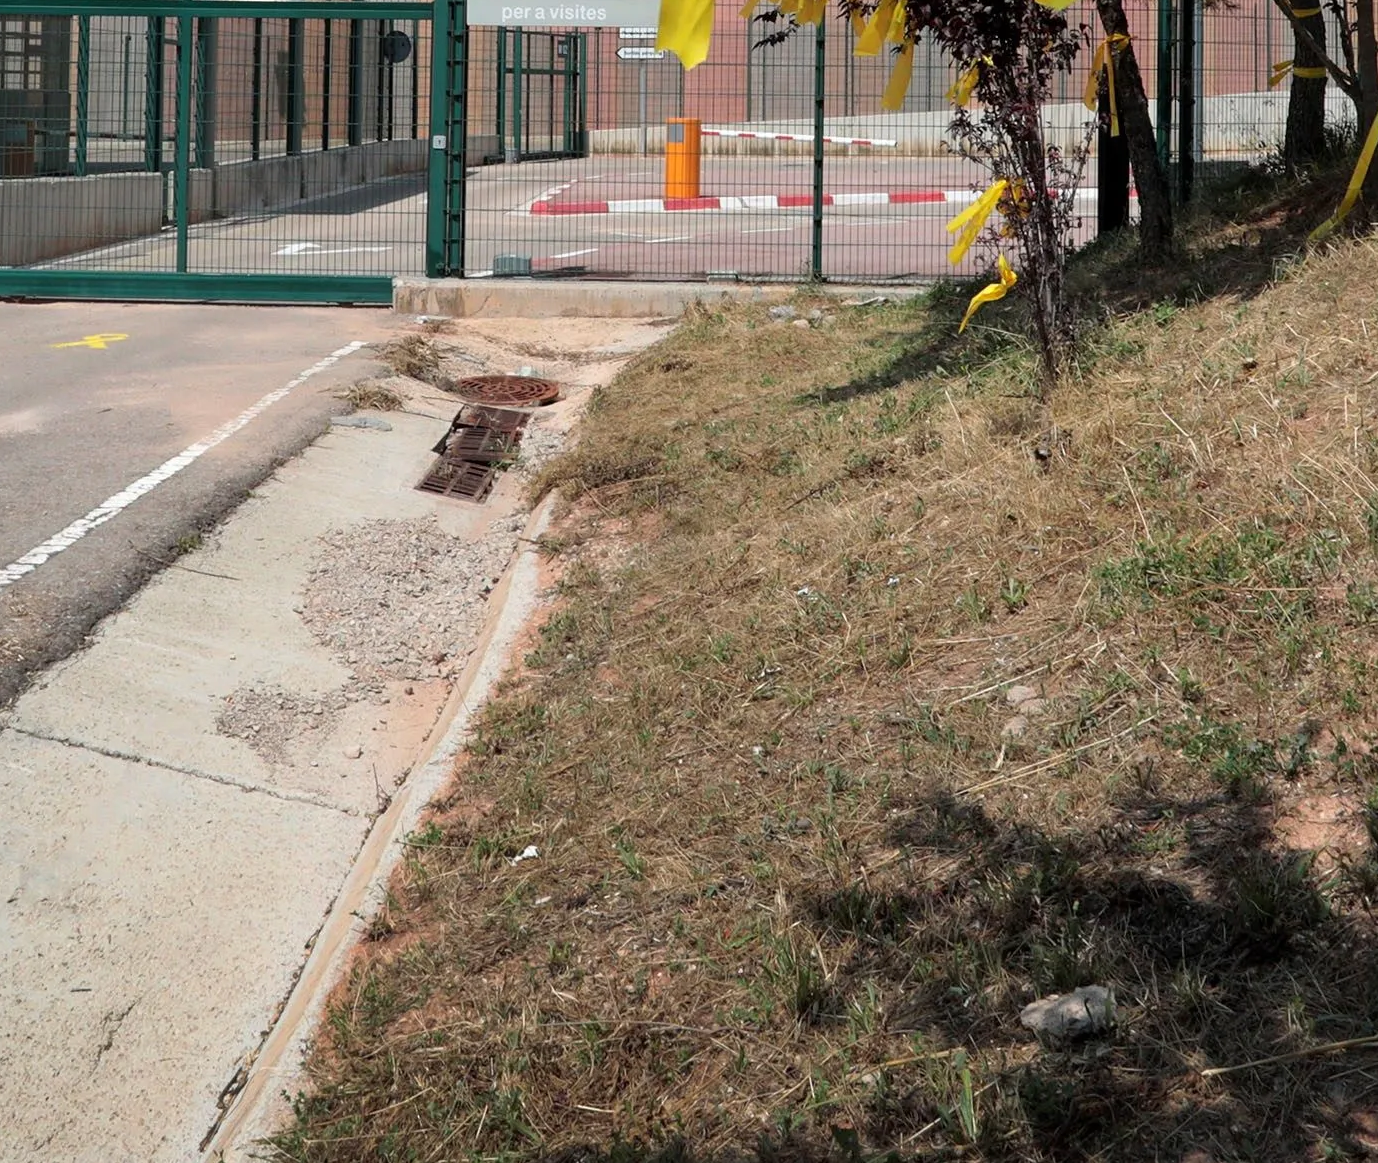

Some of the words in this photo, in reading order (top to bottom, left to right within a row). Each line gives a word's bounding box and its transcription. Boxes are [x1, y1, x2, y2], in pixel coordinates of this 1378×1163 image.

[501, 6, 533, 22] per
[535, 6, 545, 20] a
[550, 5, 607, 21] visites
